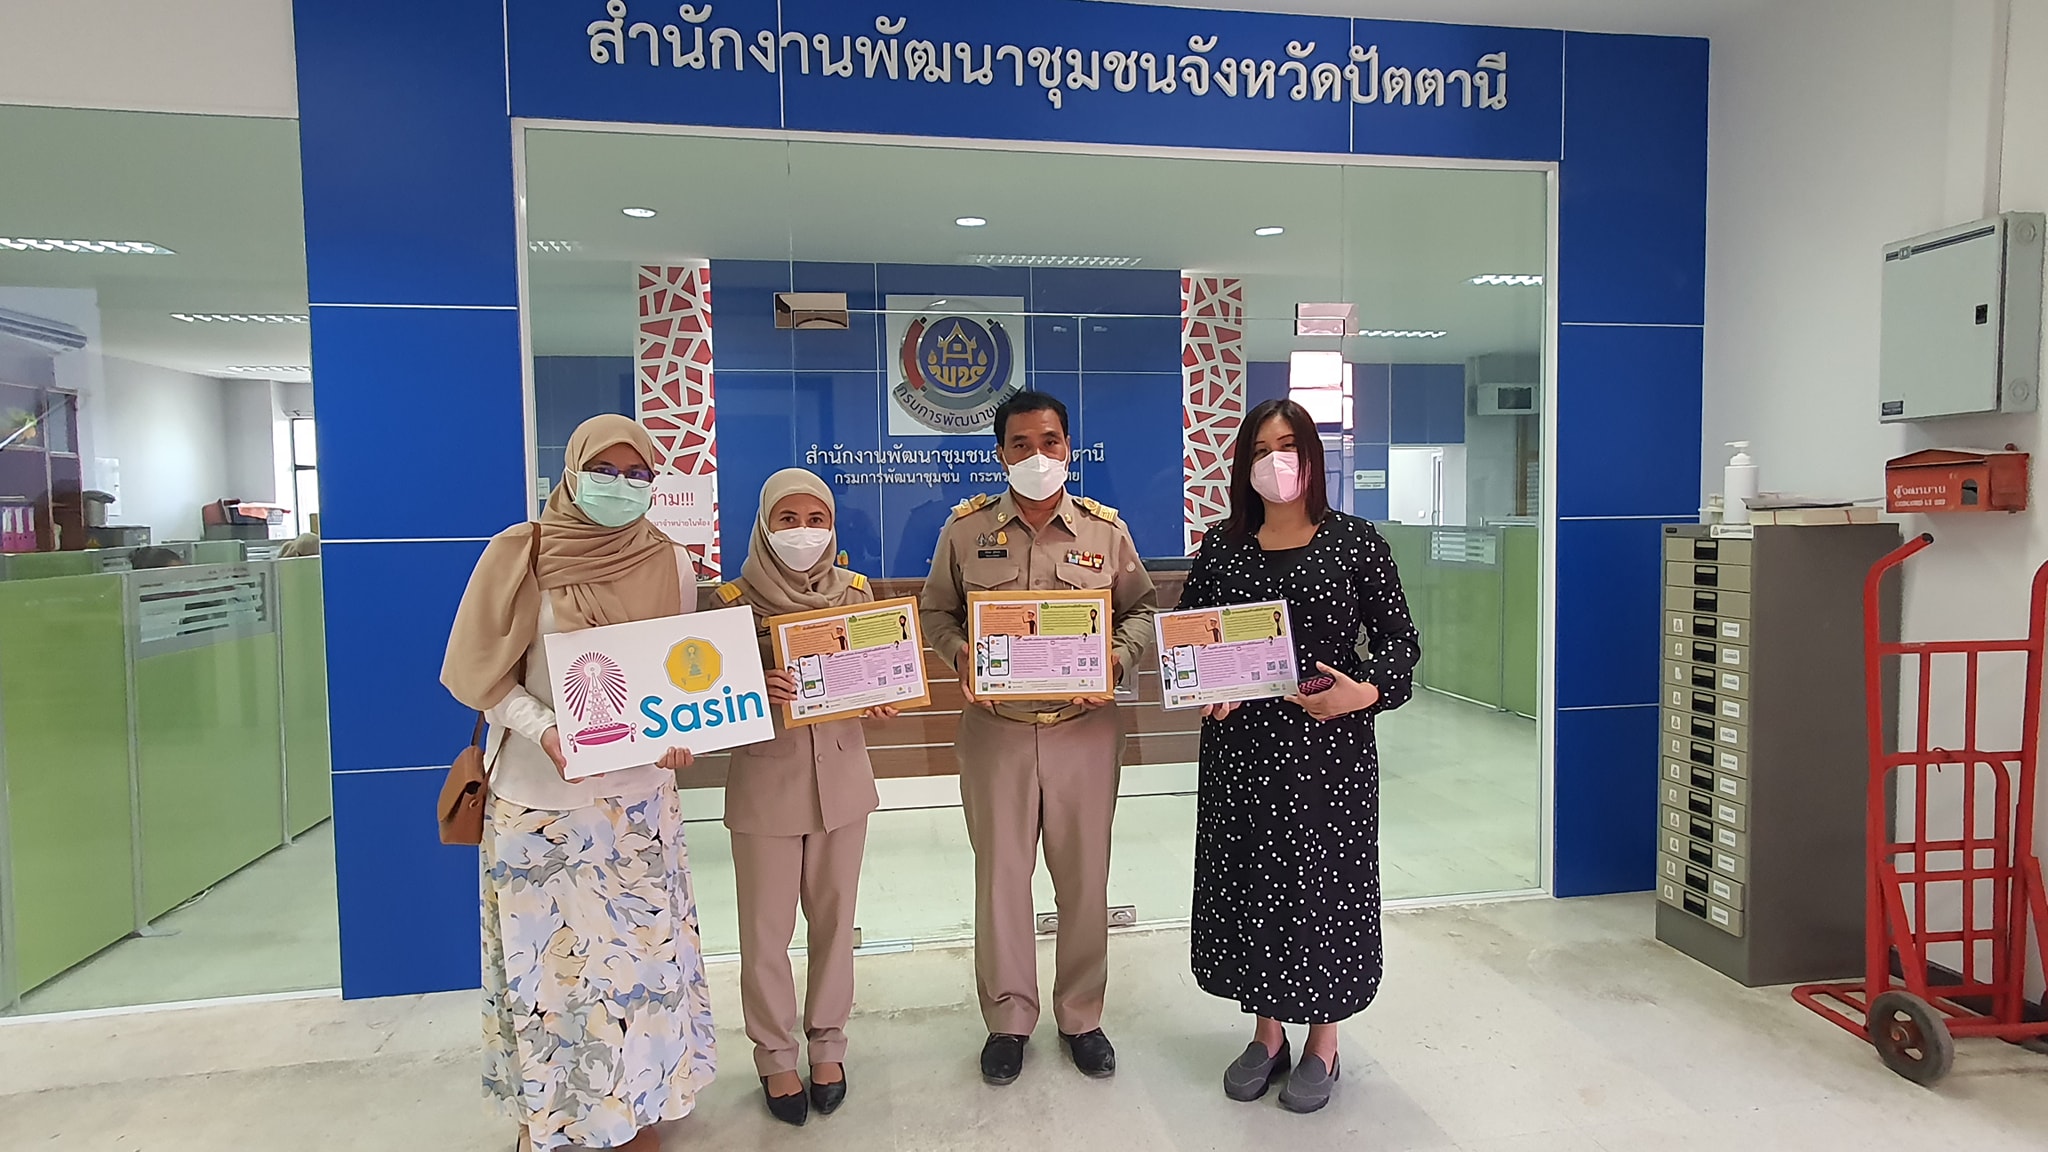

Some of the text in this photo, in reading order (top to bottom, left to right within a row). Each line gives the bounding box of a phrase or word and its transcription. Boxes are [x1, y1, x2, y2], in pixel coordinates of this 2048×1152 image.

[586, 0, 1508, 110] สำนักงานพัฒนาชุมชนจังหวัดปัตตานี
[895, 384, 1017, 427] กรมการพัฒนาช
[834, 467, 960, 487] กรมการพัฒนาชุมชน
[639, 686, 765, 738] Sasin
